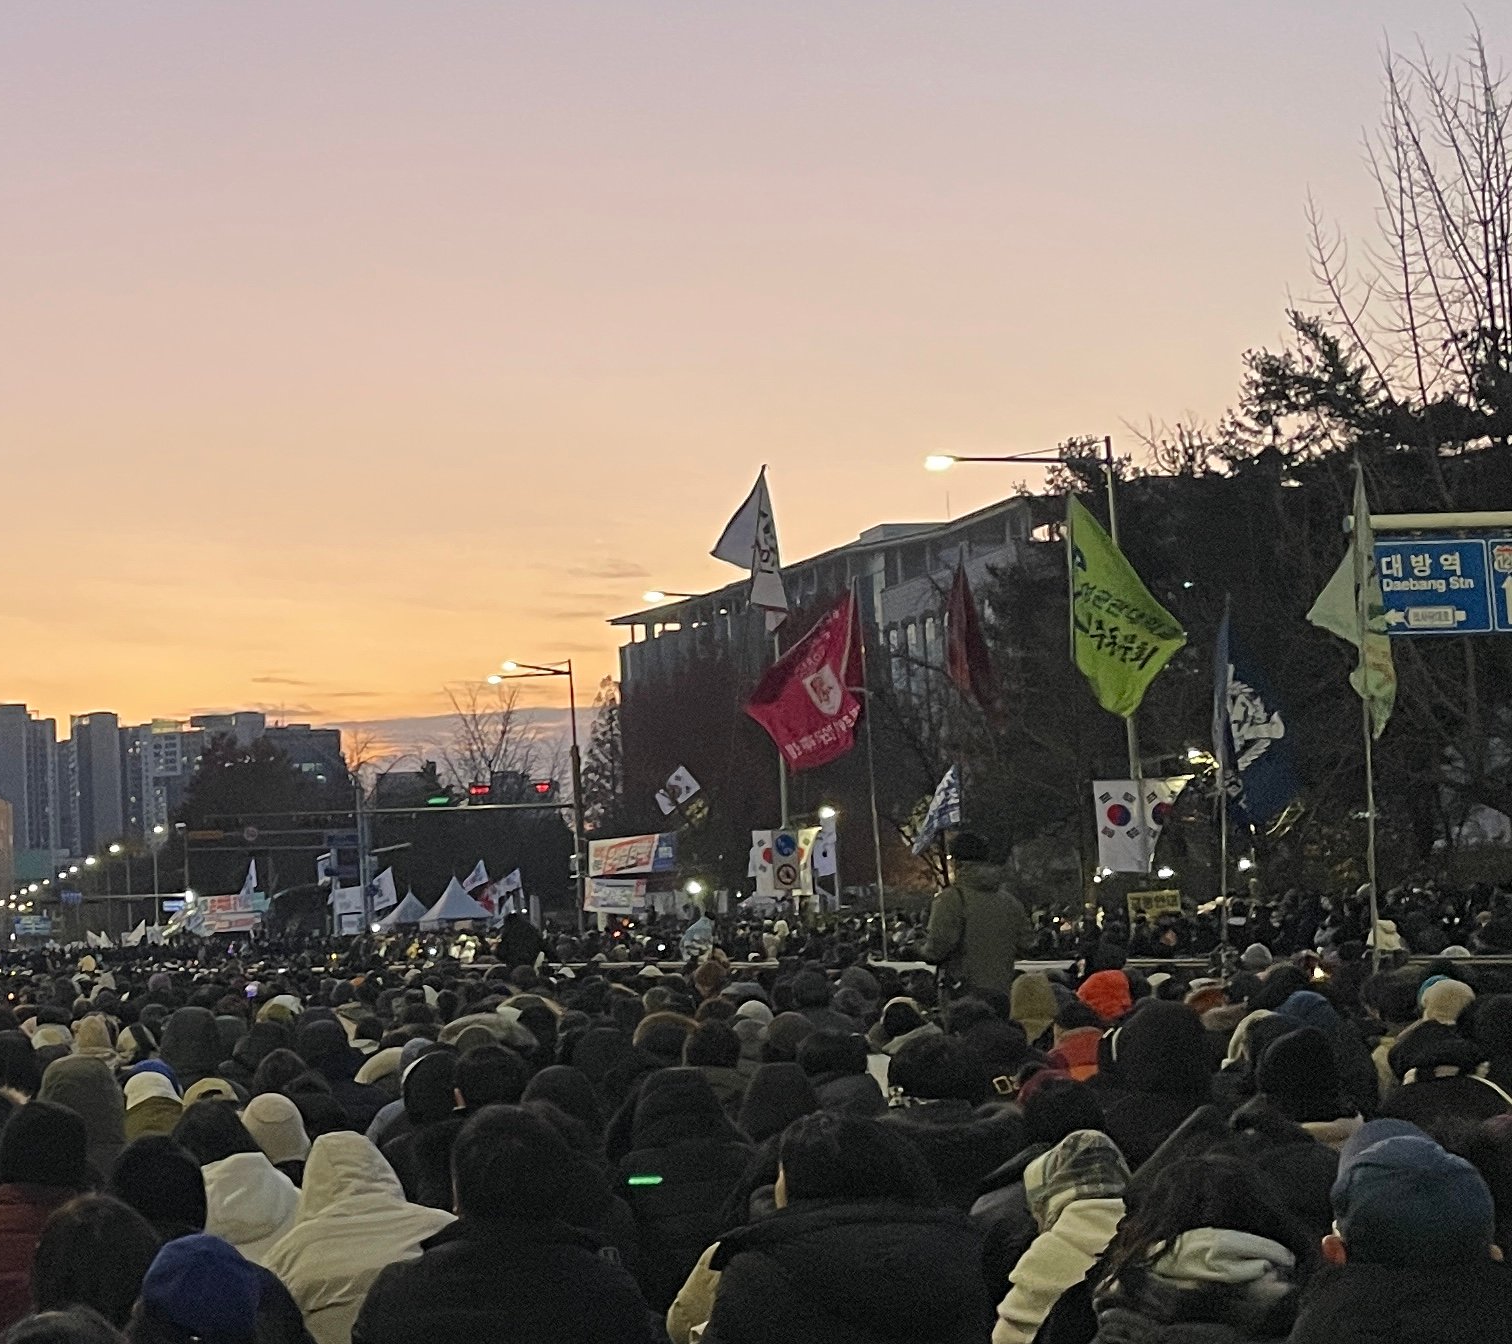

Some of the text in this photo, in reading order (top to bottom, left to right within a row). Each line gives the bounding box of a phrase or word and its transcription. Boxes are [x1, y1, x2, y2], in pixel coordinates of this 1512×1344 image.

[1381, 552, 1462, 577] 대방역
[1382, 575, 1475, 593] Daebang Stn
